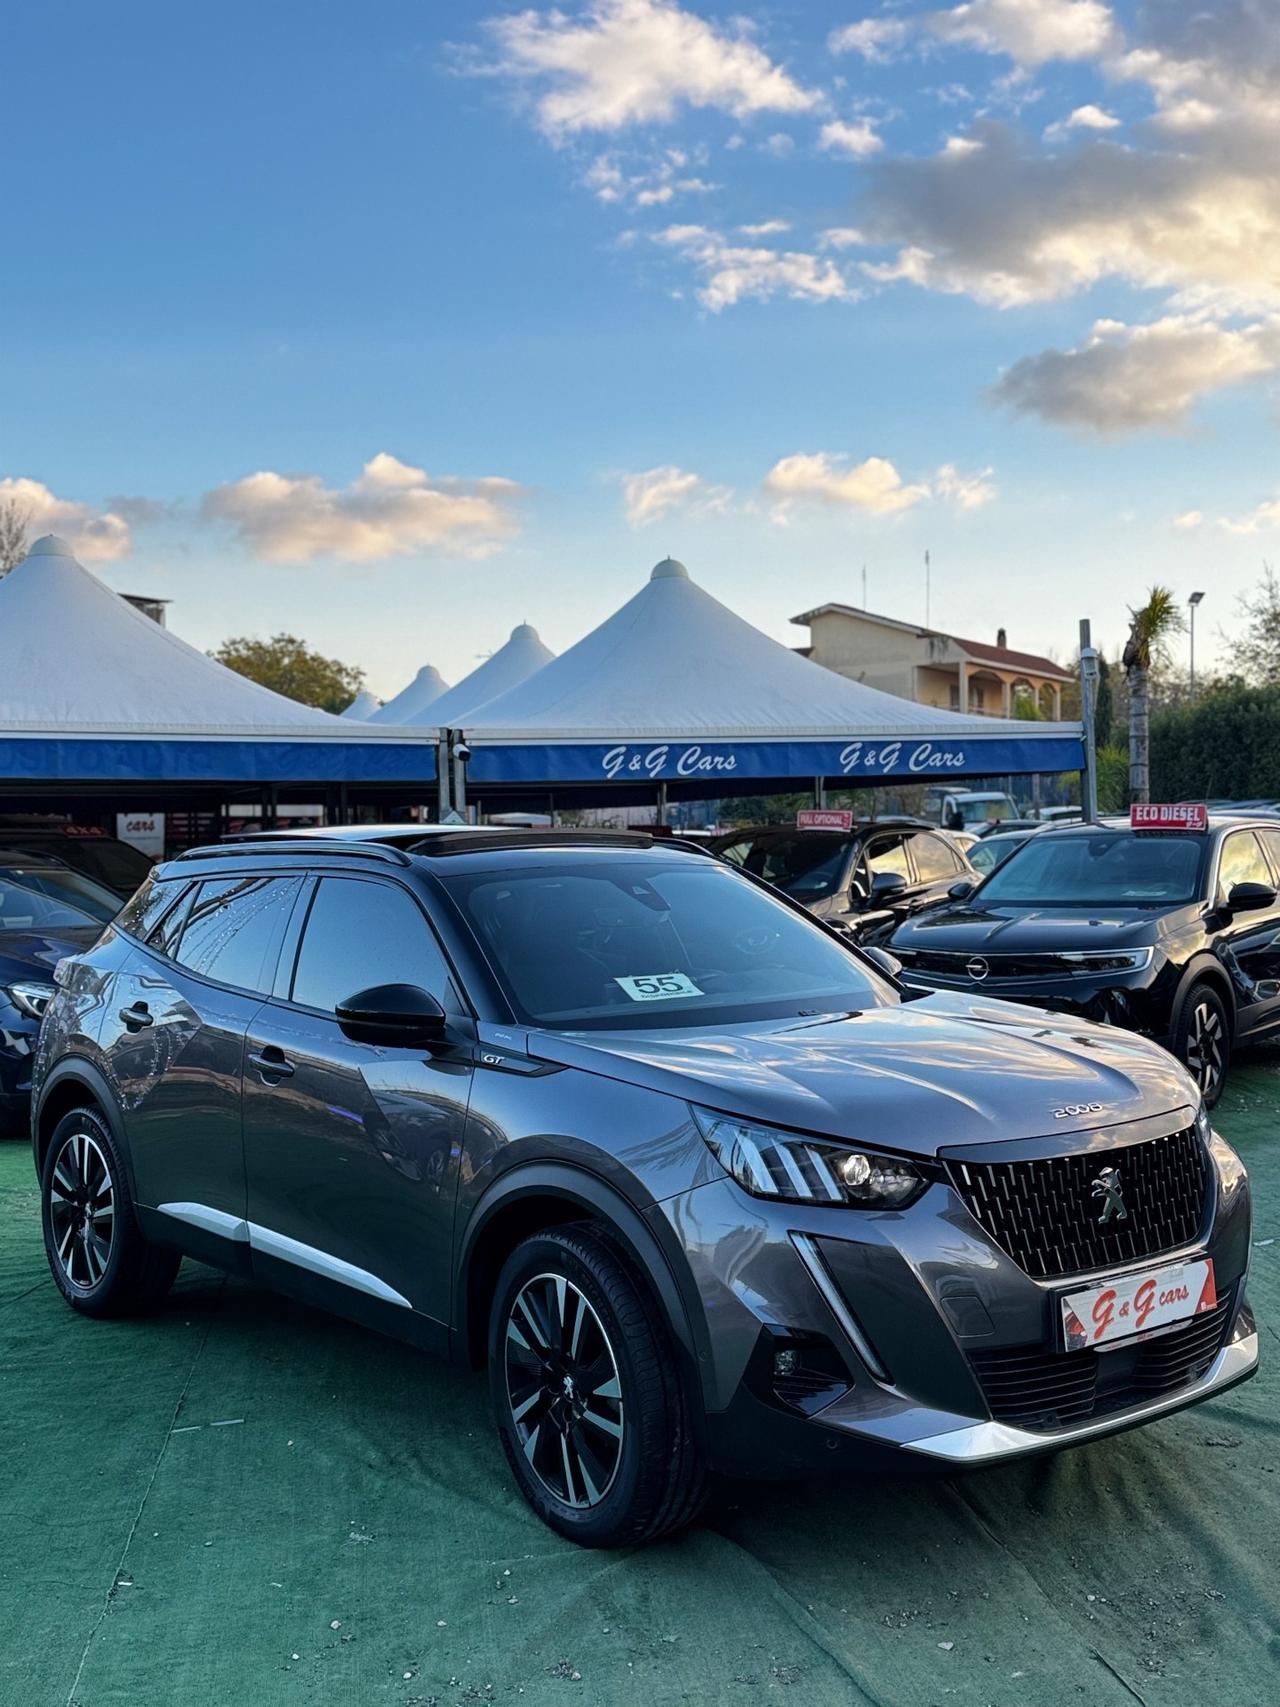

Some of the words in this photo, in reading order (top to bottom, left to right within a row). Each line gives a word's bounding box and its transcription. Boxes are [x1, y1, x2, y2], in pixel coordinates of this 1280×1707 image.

[677, 746, 737, 775] Cars
[908, 743, 965, 771] Cars
[1136, 806, 1158, 820] ECO
[1160, 806, 1201, 821] DIESEL
[632, 976, 684, 994] 55
[483, 1054, 505, 1064] GT
[1051, 1102, 1103, 1118] 2008
[1159, 1284, 1189, 1306] cars
